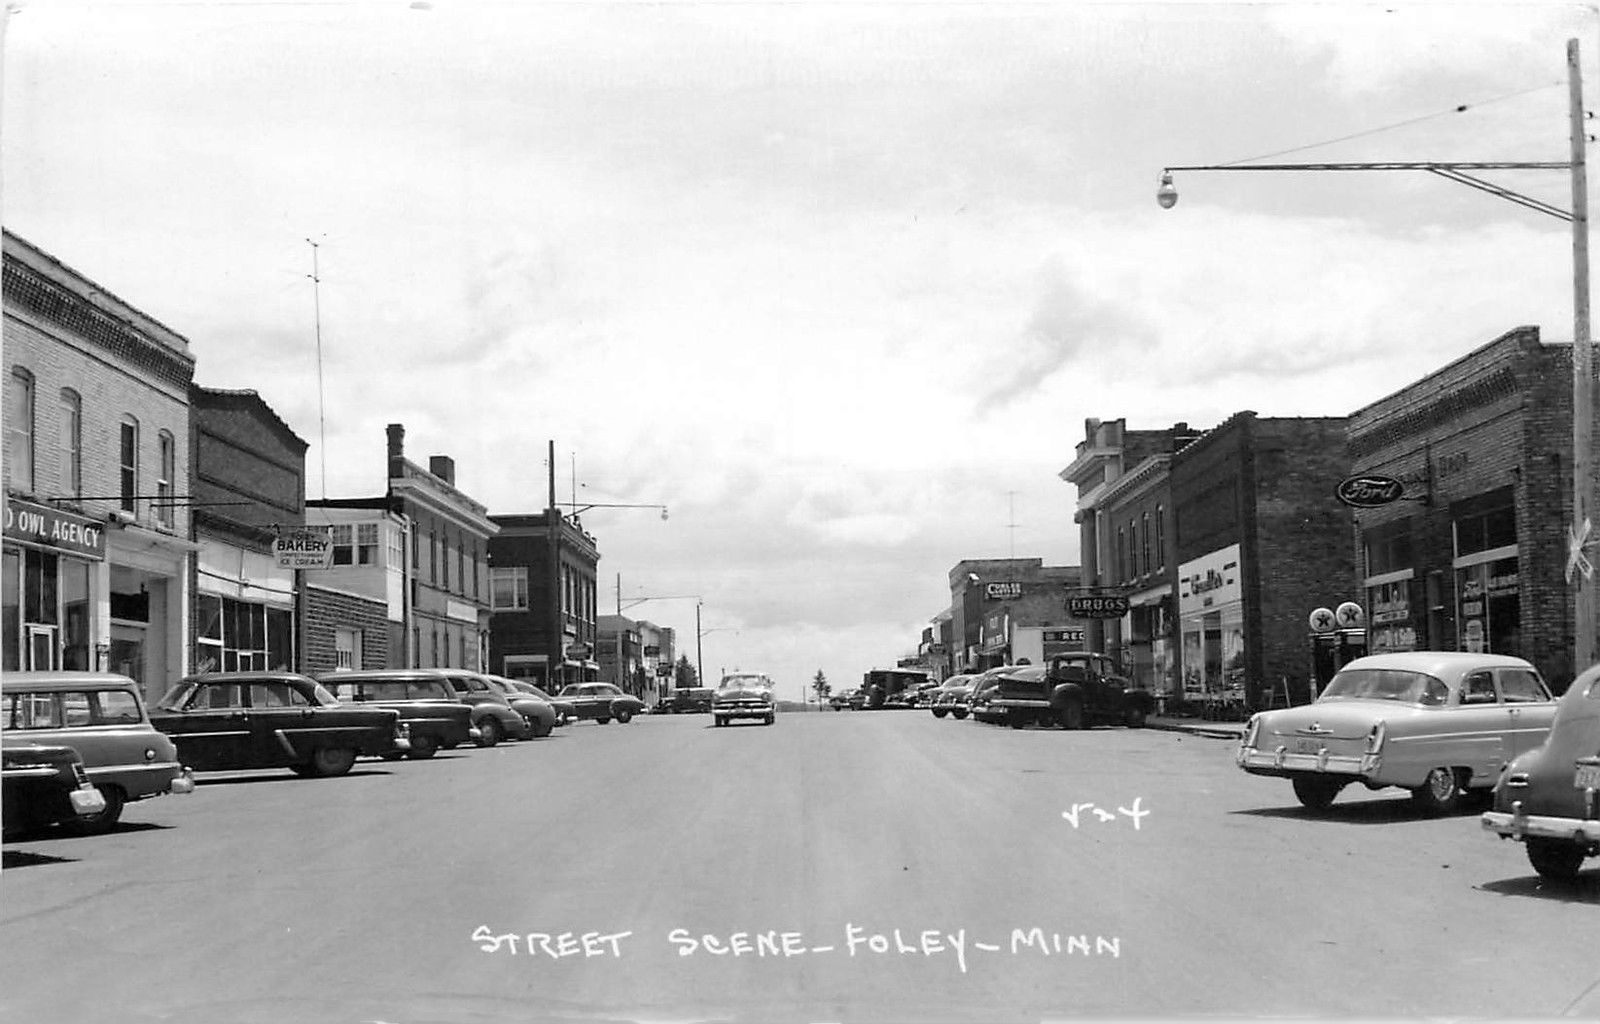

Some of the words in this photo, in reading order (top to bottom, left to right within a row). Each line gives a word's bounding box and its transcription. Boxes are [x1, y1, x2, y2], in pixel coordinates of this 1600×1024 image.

[1345, 479, 1399, 499] Ford
[19, 511, 46, 536] OWL
[51, 519, 100, 548] AGENCY
[277, 540, 329, 551] BAKERY
[1070, 598, 1127, 611] DRUGS
